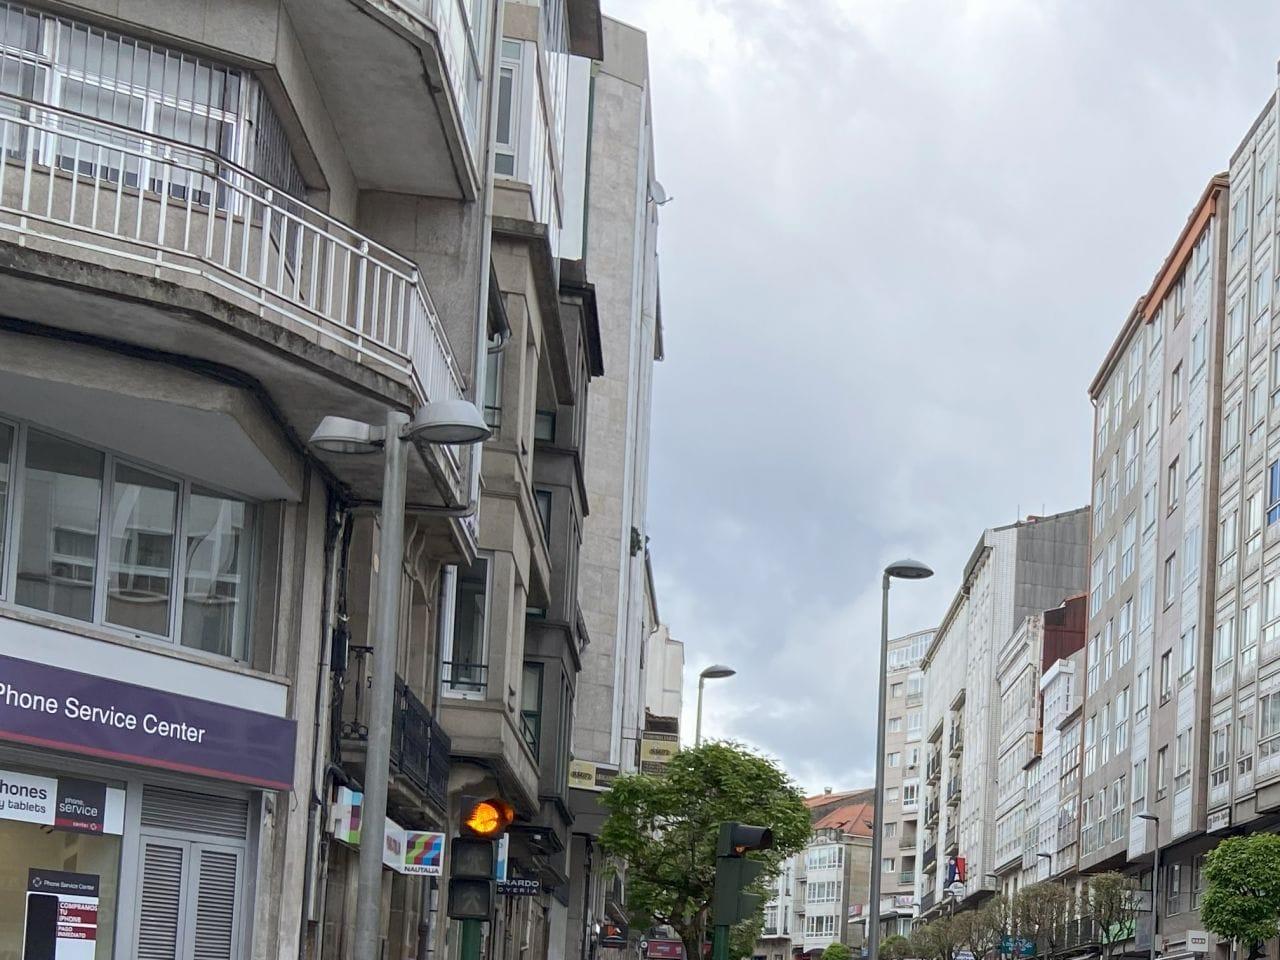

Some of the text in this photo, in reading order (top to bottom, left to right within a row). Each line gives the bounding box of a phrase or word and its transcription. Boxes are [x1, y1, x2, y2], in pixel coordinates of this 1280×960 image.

[64, 697, 137, 730] Service
[143, 714, 206, 744] Center
[8, 799, 47, 814] tablets
[59, 803, 98, 817] service
[404, 866, 440, 874] NAUTALIA
[43, 879, 60, 887] Phone
[60, 881, 78, 889] Service
[59, 902, 98, 912] COMPRAMOS
